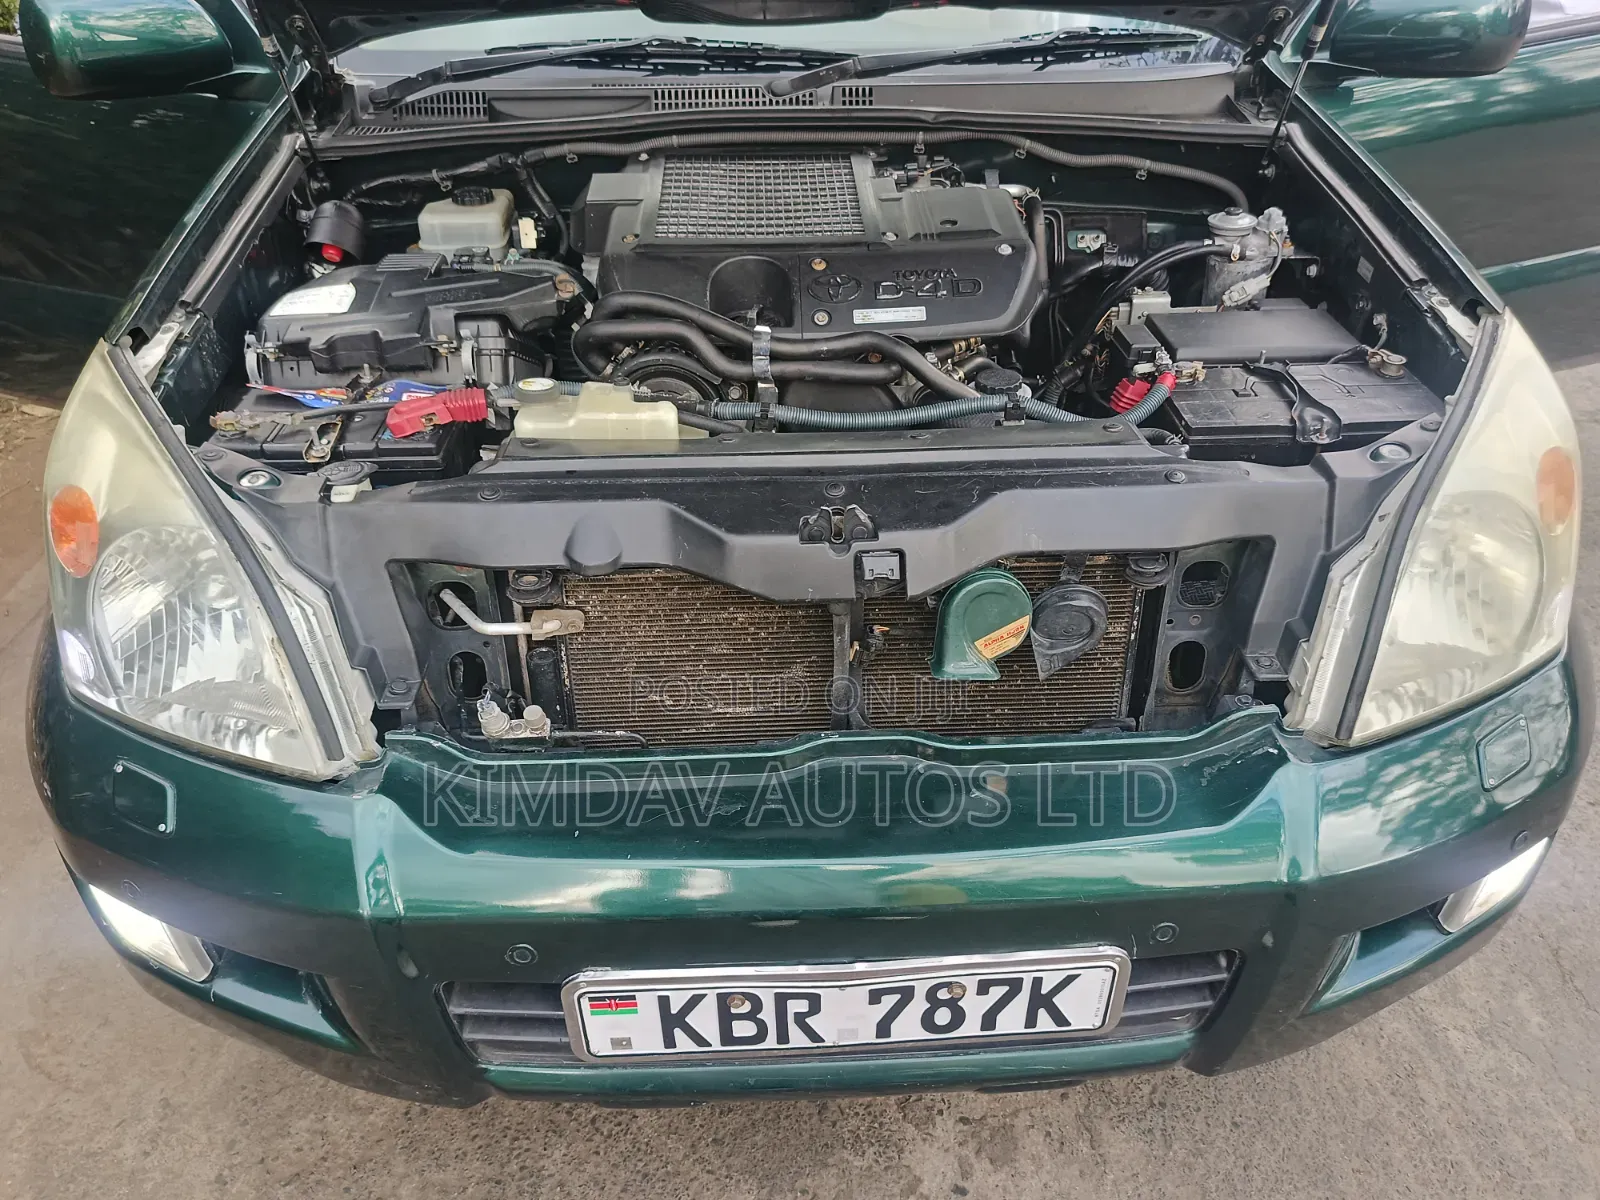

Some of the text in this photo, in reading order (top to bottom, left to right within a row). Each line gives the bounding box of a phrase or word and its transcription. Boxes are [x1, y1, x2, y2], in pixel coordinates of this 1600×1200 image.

[892, 268, 958, 281] TOYOTA
[657, 991, 826, 1049] KBR
[868, 973, 1082, 1039] 787K
